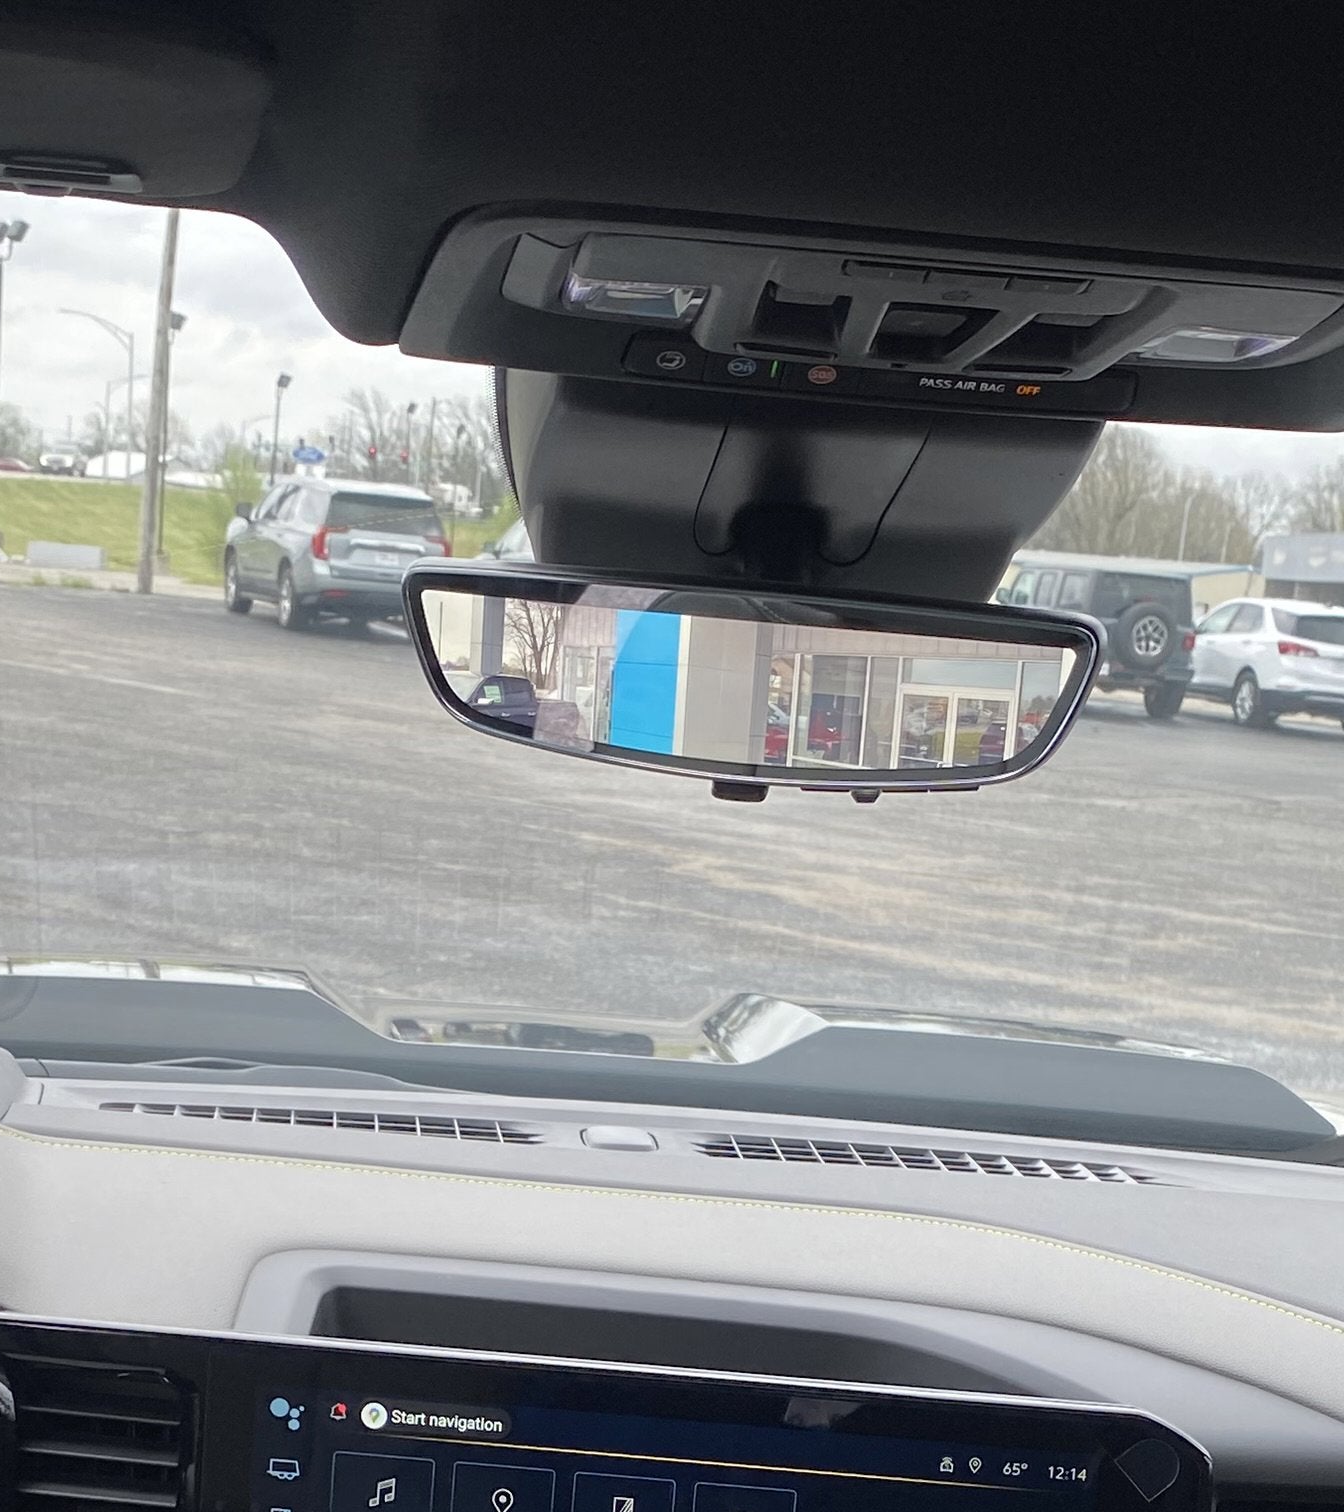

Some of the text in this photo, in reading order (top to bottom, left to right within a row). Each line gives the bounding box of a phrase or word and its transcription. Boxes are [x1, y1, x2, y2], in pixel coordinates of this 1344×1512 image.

[919, 378, 1041, 396] PASS AIR BAG OFF
[391, 1409, 503, 1432] Start navigation
[1002, 1462, 1028, 1476] 65°
[1048, 1466, 1087, 1482] 12:14
